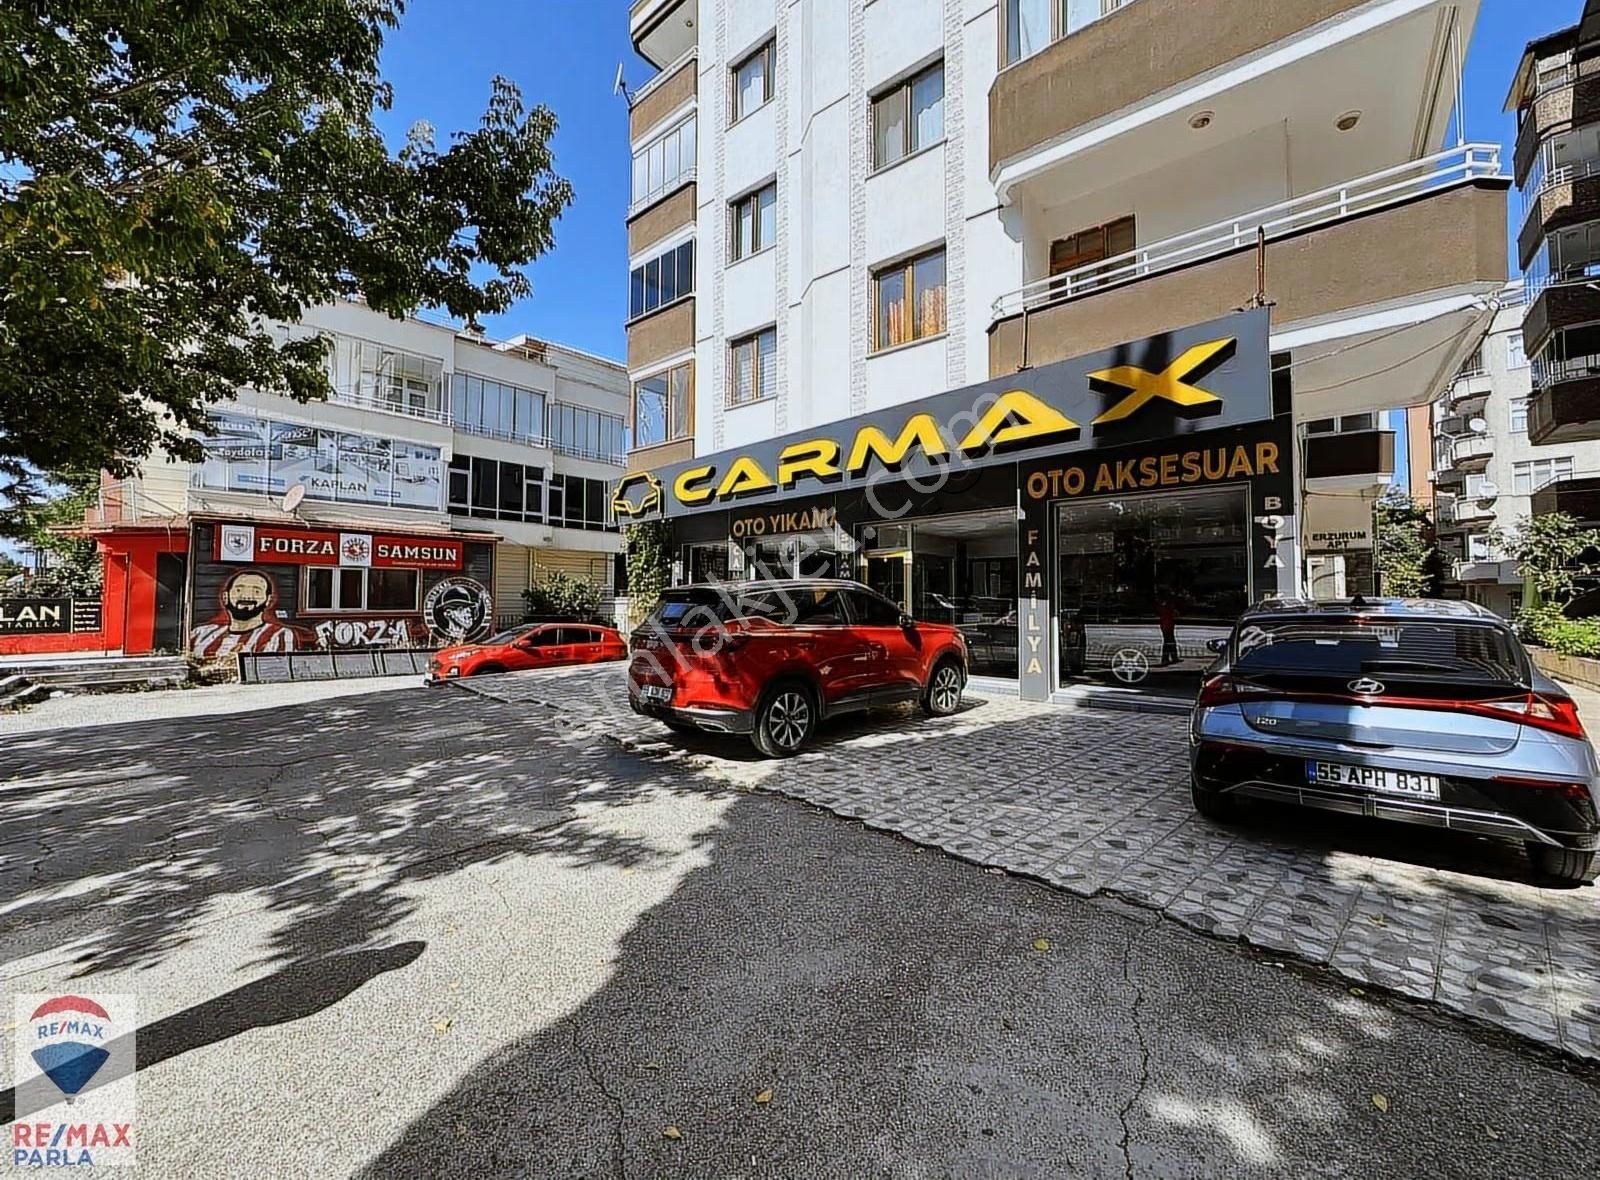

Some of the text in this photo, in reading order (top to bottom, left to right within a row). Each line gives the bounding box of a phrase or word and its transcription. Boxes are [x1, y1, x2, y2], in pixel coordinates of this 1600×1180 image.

[672, 335, 1237, 503] CARMAX
[1027, 442, 1280, 499] OTO AKSESUAR
[311, 478, 367, 492] KAPLAN
[733, 517, 765, 537] OTO
[1262, 496, 1286, 569] BOYA
[1312, 531, 1366, 541] ERZURUM
[260, 537, 335, 555] FORZA
[378, 544, 457, 561] SAMSUN
[1327, 541, 1349, 549] APT
[315, 619, 409, 649] FORZA
[1317, 762, 1435, 794] 55 APH 831
